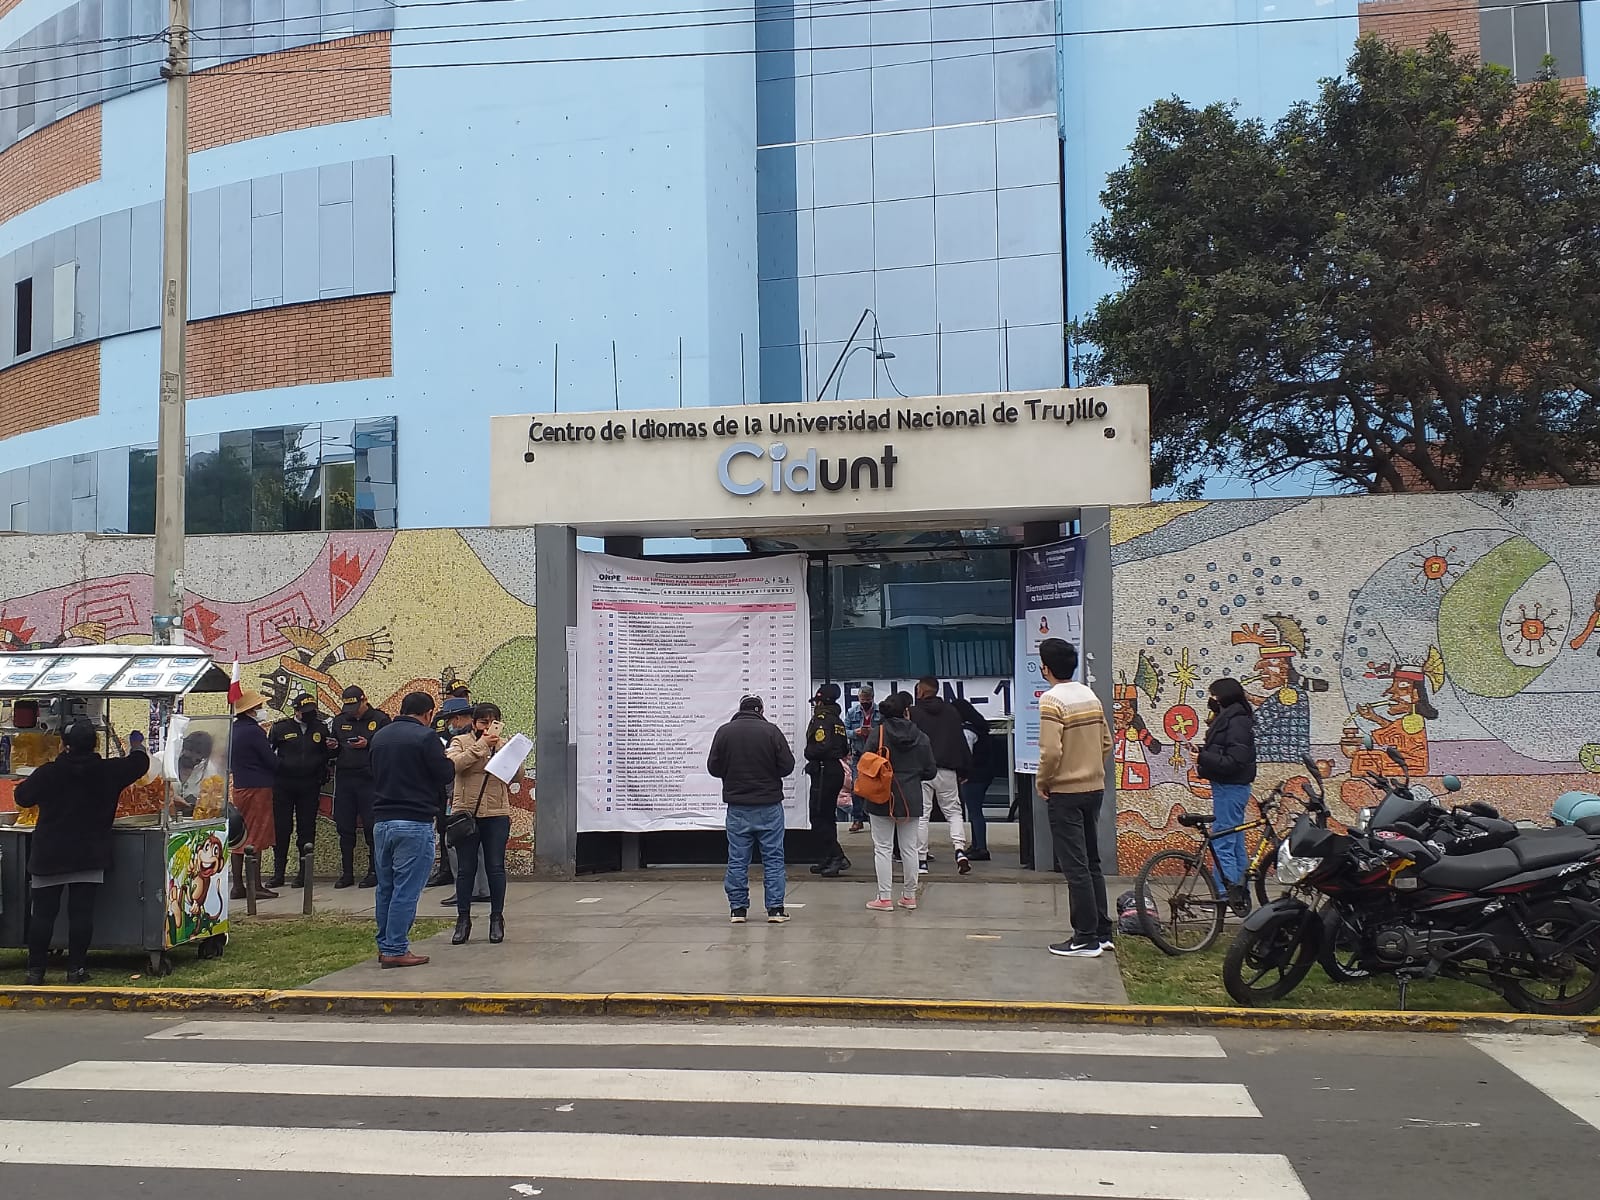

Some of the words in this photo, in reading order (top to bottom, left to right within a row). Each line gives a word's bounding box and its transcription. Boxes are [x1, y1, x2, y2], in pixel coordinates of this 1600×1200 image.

[529, 422, 596, 442] Centro
[600, 420, 626, 441] de
[632, 417, 707, 439] Idiomas
[713, 415, 739, 436] de
[745, 415, 762, 435] la
[769, 408, 891, 433] Universidad
[898, 403, 986, 429] Nacional
[993, 401, 1019, 422] de
[1025, 397, 1108, 425] Trujillo
[718, 441, 898, 495] Cidunt
[599, 574, 621, 582] ONPE
